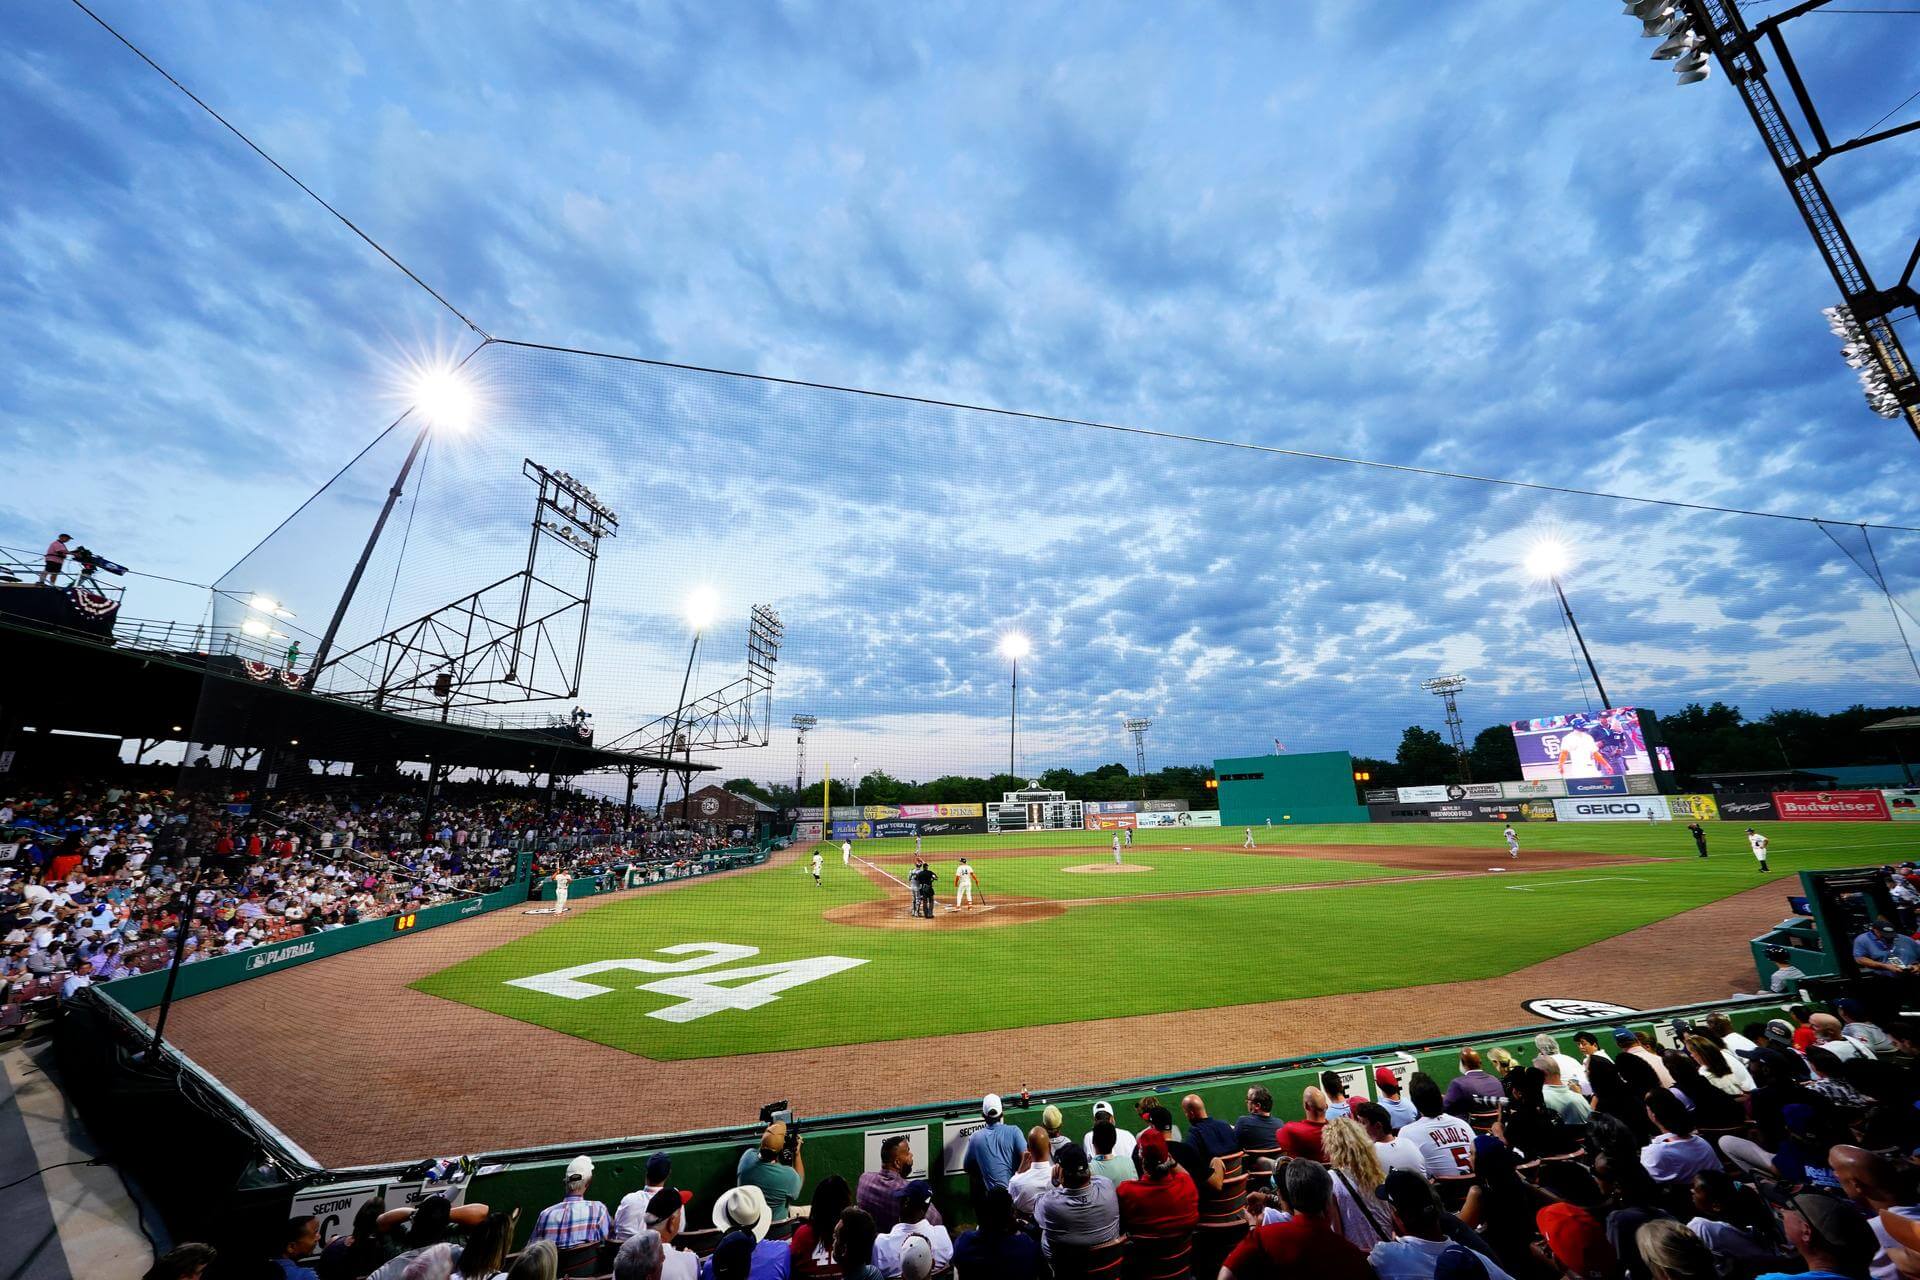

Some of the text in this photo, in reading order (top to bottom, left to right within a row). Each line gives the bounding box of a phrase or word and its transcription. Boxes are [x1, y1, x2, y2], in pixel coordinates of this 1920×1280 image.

[1576, 803, 1641, 815] GEICO
[1784, 801, 1876, 812] Budweiser
[502, 941, 873, 1023] 24
[1429, 1127, 1470, 1147] PUJOLS
[1450, 1147, 1473, 1170] 5
[312, 1198, 352, 1216] SECTION
[319, 1214, 340, 1249] C
